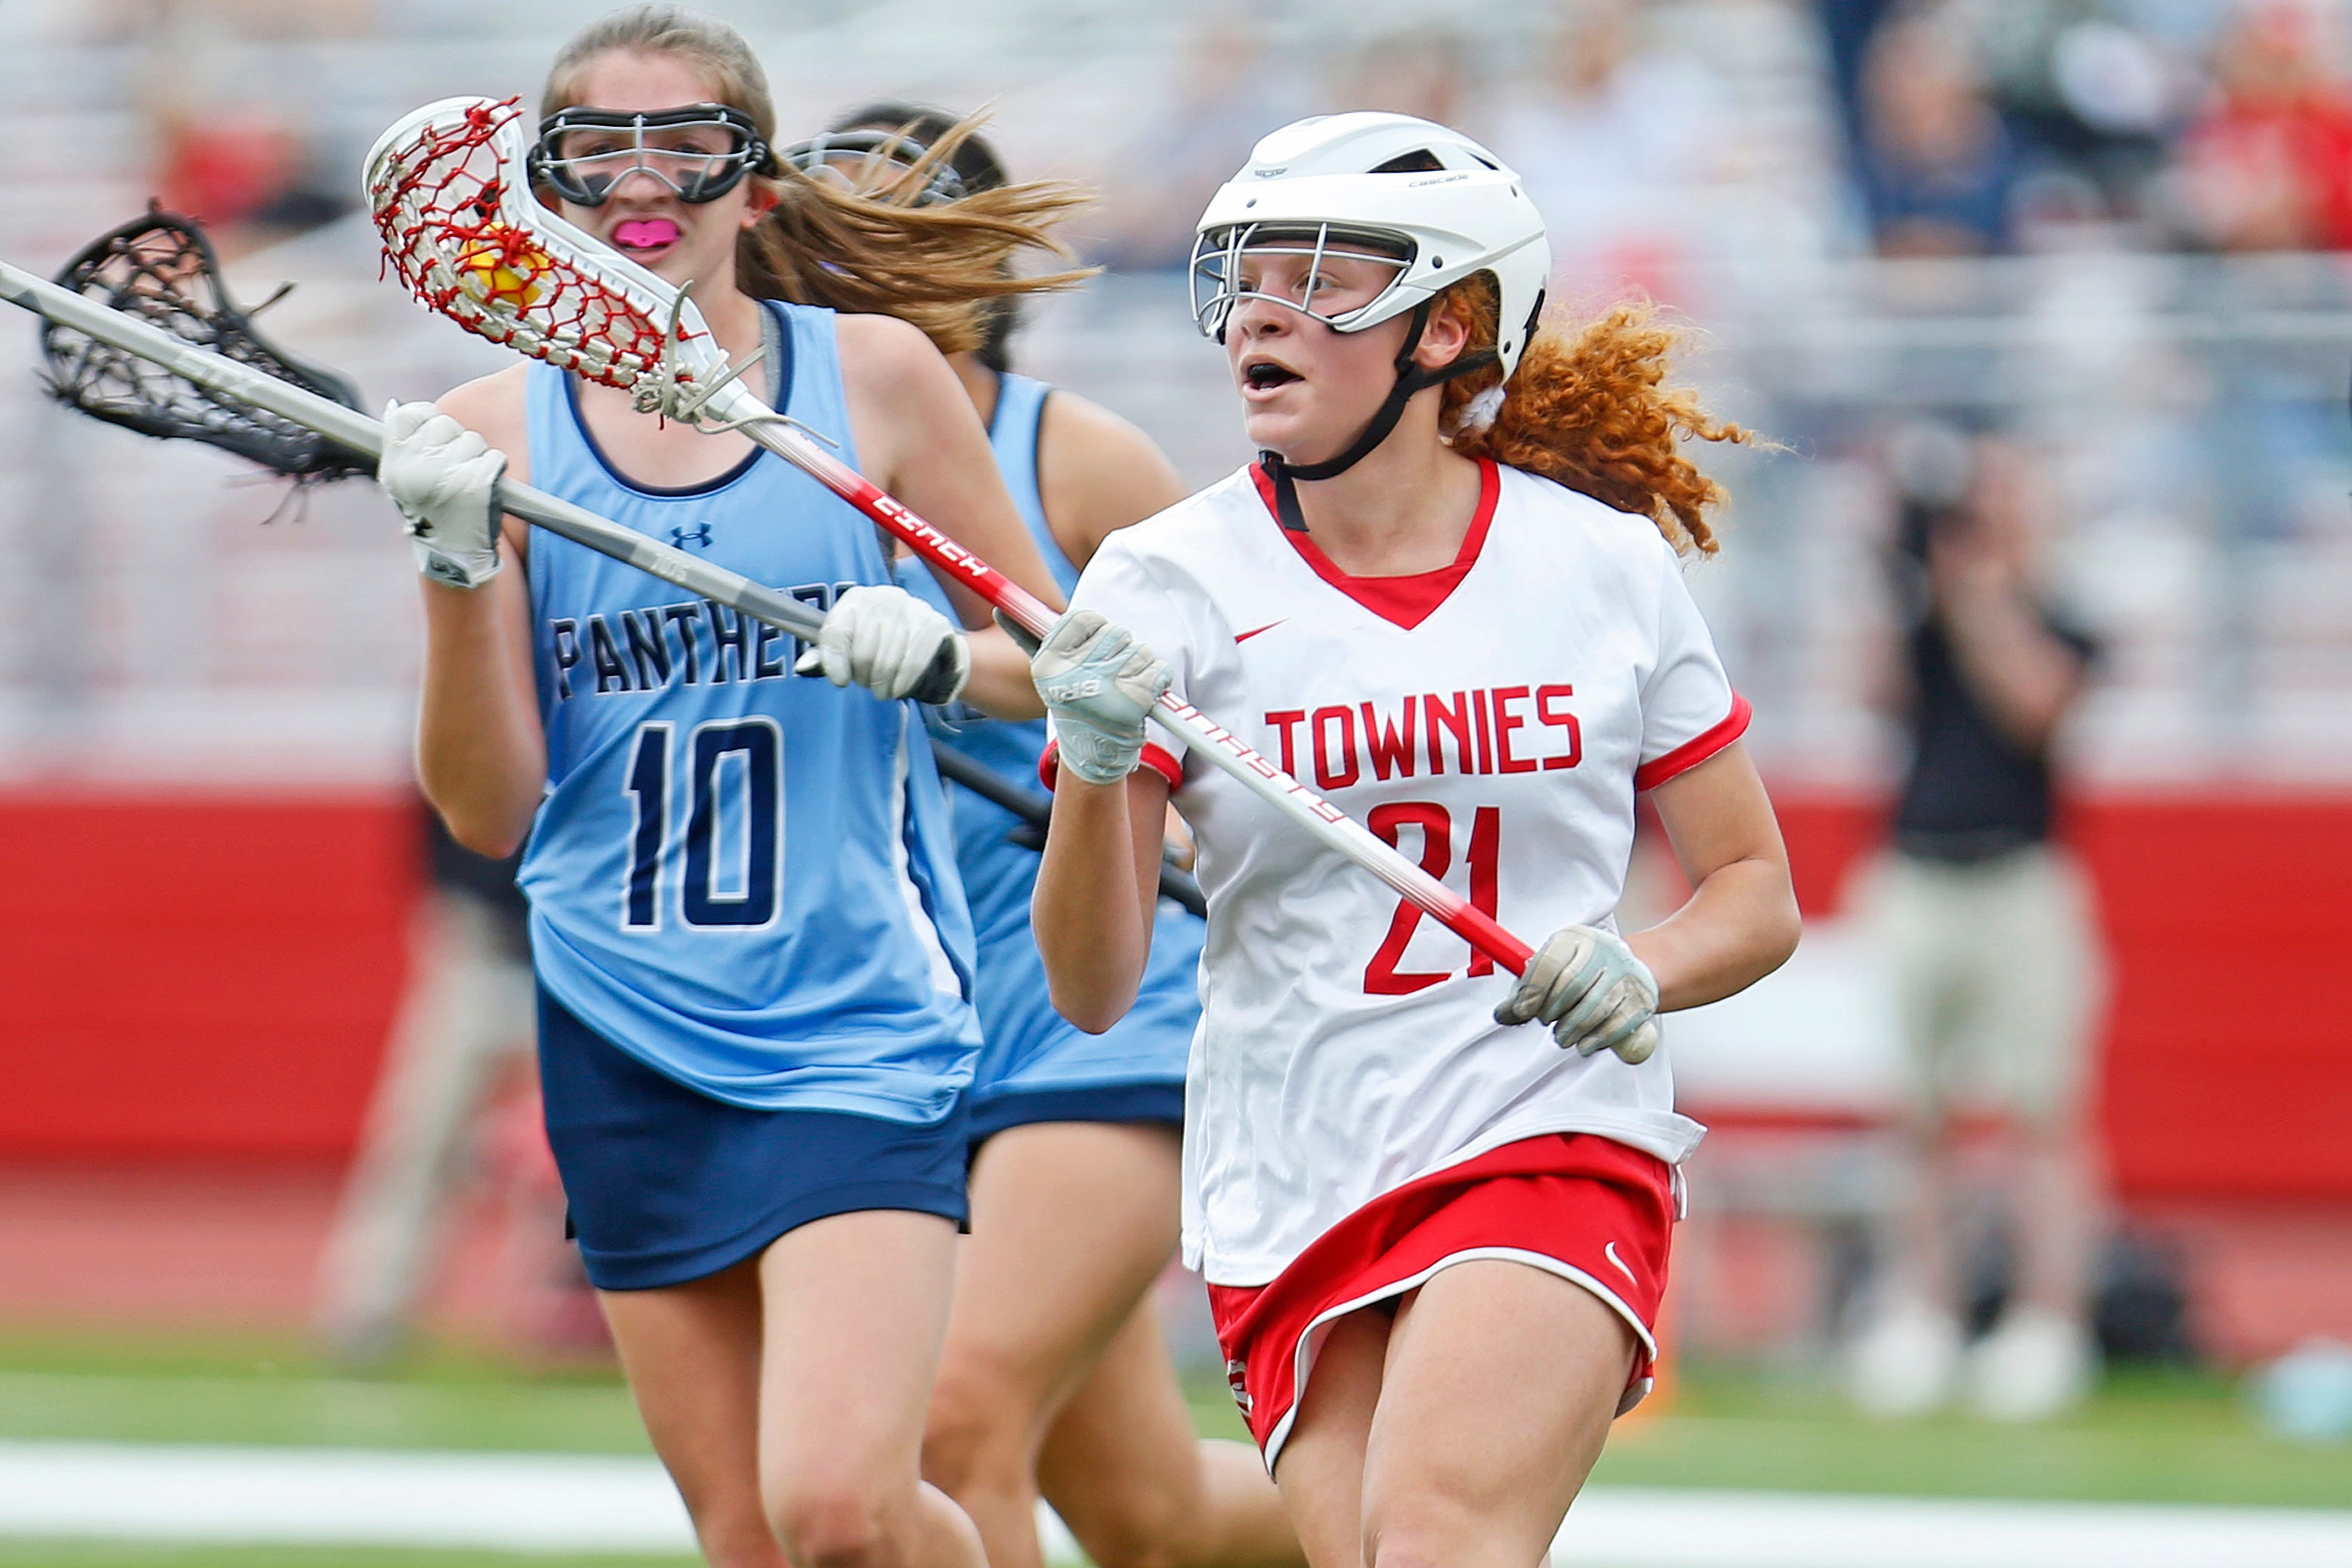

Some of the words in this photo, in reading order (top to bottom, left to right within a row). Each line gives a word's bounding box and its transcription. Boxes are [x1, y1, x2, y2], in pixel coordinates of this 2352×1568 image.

[872, 495, 989, 576] CINCH
[550, 581, 859, 699] PANTHER
[1265, 684, 1582, 791] TOWNIES
[620, 714, 785, 933] 10
[1363, 800, 1501, 996] 21
